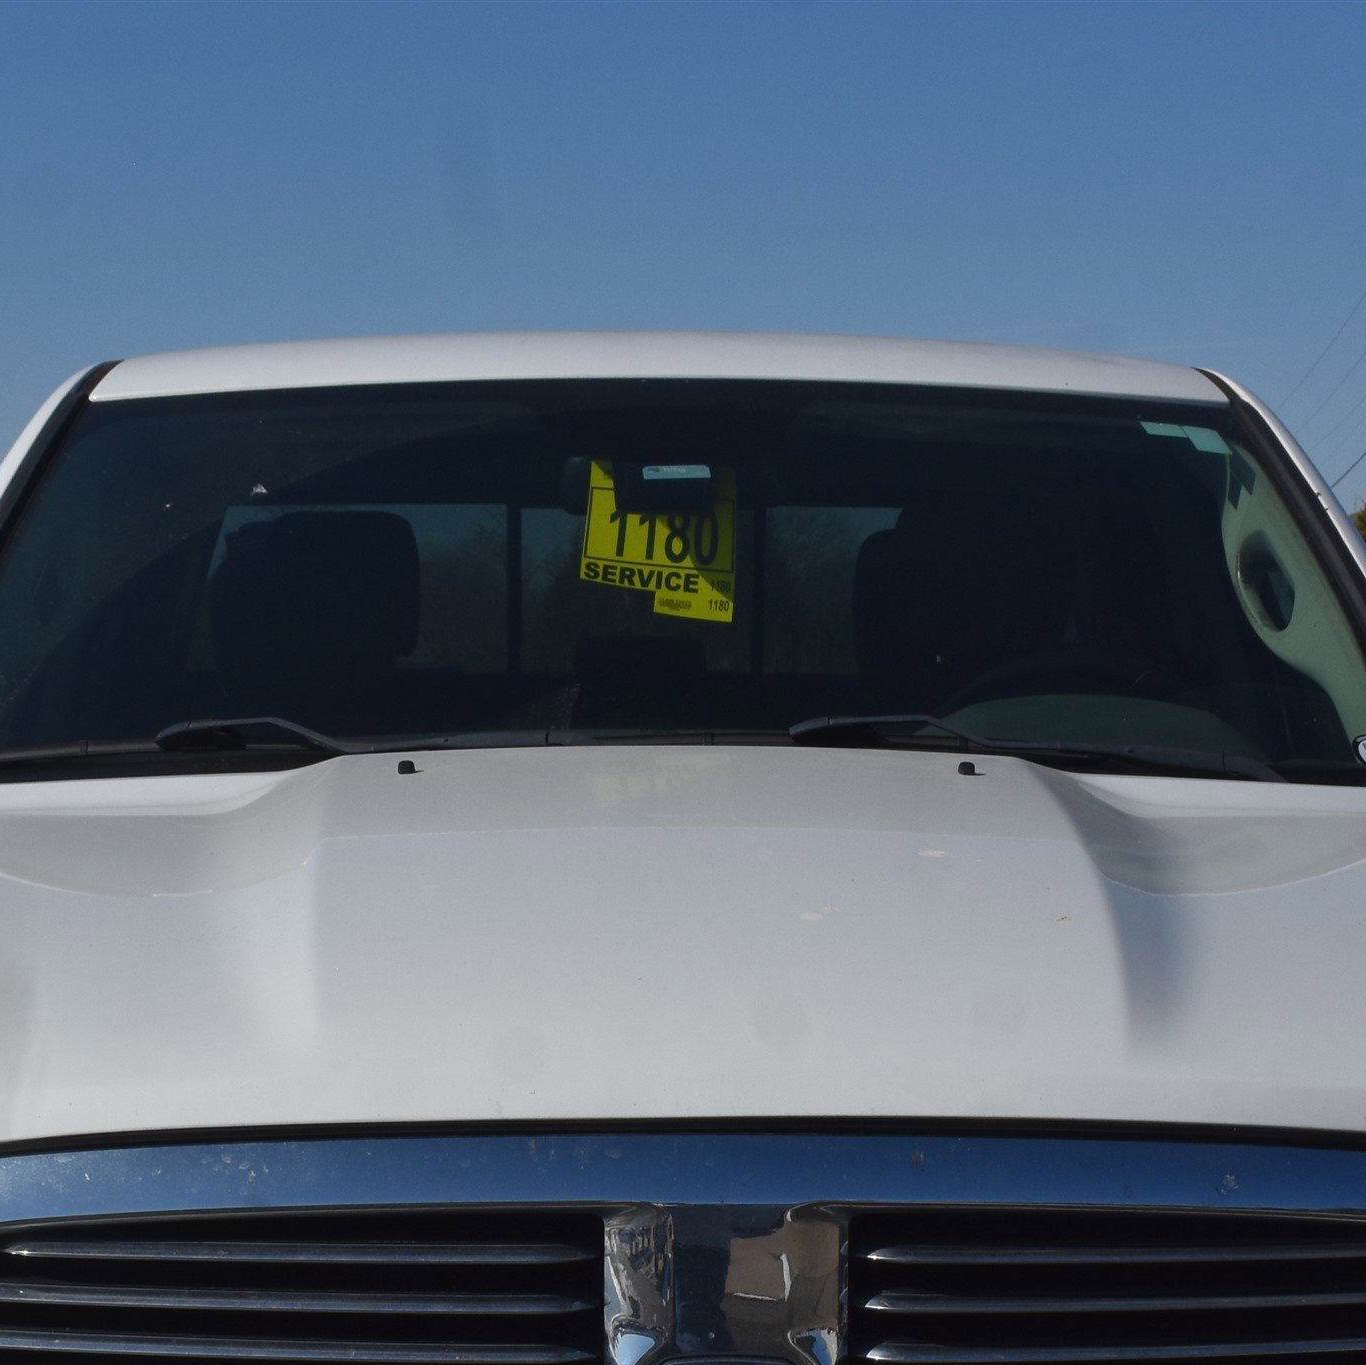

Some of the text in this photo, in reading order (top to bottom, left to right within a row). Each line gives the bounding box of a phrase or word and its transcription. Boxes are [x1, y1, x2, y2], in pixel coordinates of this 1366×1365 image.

[610, 510, 719, 566] 1180
[584, 562, 699, 593] SERVICE
[708, 598, 730, 612] 1180
